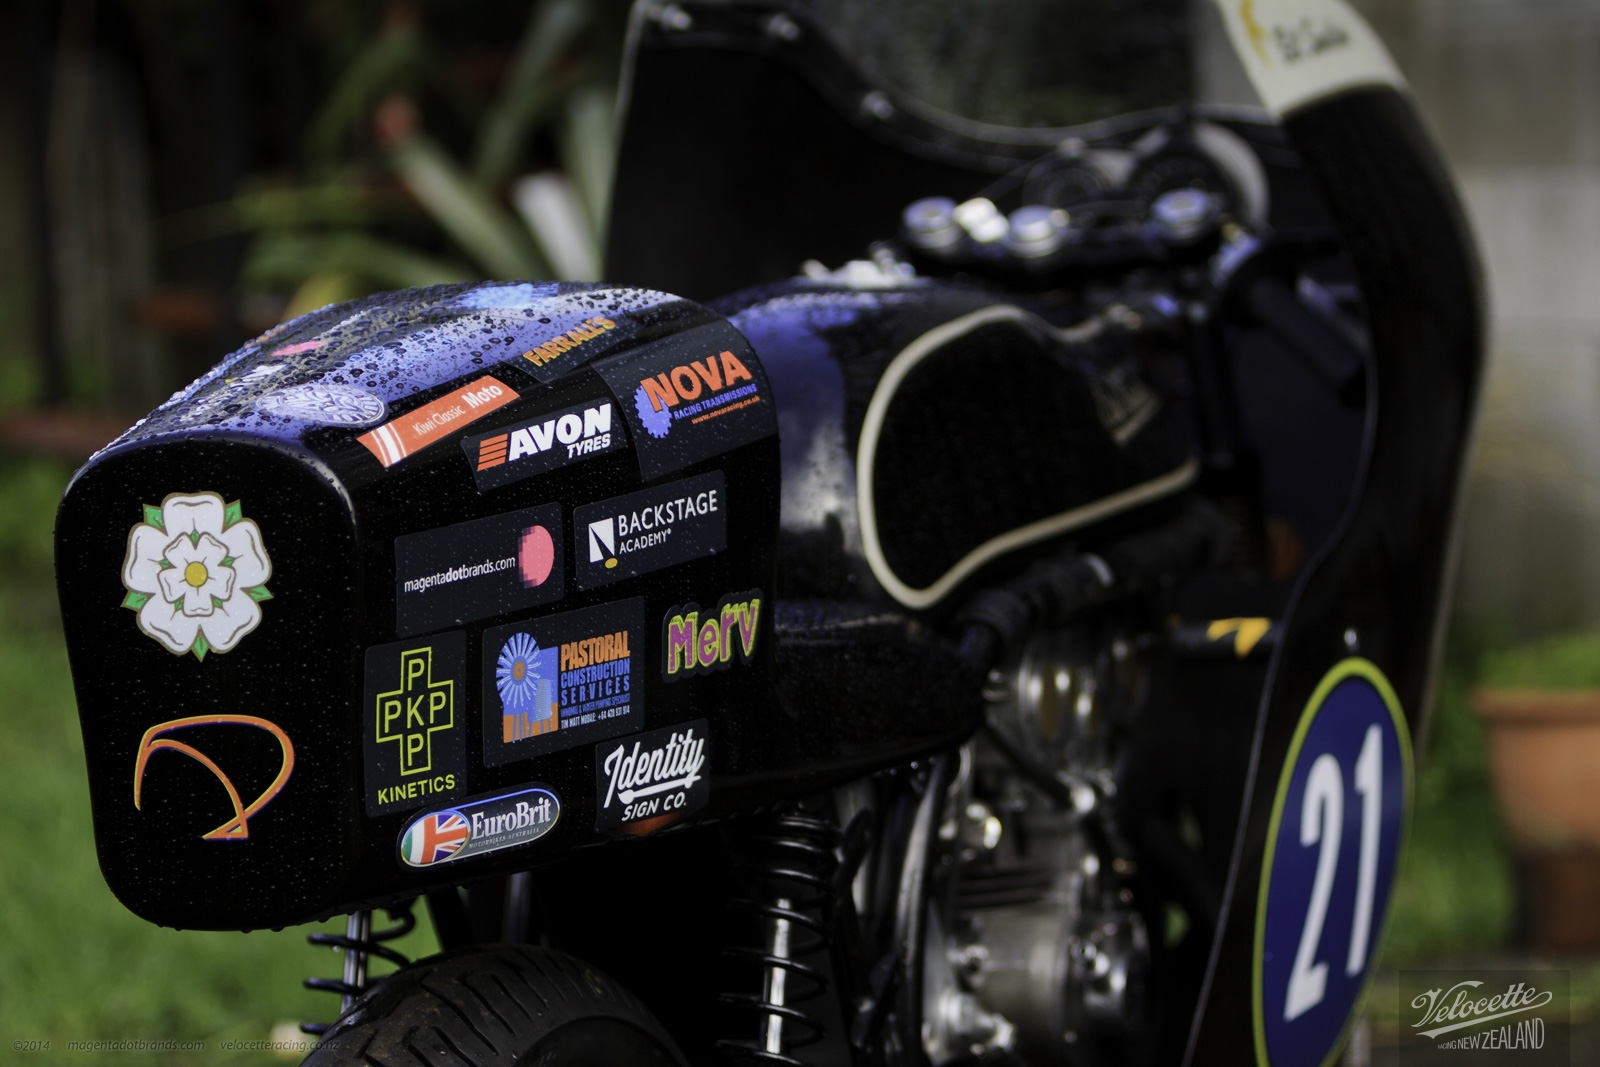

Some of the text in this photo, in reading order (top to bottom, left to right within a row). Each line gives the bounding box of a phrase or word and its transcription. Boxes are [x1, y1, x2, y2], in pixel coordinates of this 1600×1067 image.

[522, 315, 616, 367] FARRALL'S
[640, 350, 753, 412] NOVA
[673, 383, 758, 420] RACING TRANSMISSIONS
[412, 384, 503, 437] Kiwi Classic Moto
[691, 395, 761, 425] www.novaracing.co.uk
[508, 403, 612, 462] AVON
[566, 433, 611, 460] TYRES
[617, 489, 719, 537] BACKSTAGE
[404, 555, 516, 593] magentadotbrands.com
[560, 630, 631, 672] PASTORAL
[667, 598, 761, 675] Merv
[407, 658, 425, 691] P
[560, 657, 630, 689] CONSTRUCTION
[560, 675, 630, 706] SERVICES
[384, 691, 447, 734] PKP
[407, 732, 425, 767] P
[603, 728, 705, 809] Identity
[378, 773, 455, 805] KINETICS
[621, 791, 687, 822] SIGN CO.
[471, 798, 551, 841] EuroBrit
[1284, 722, 1383, 1022] 21
